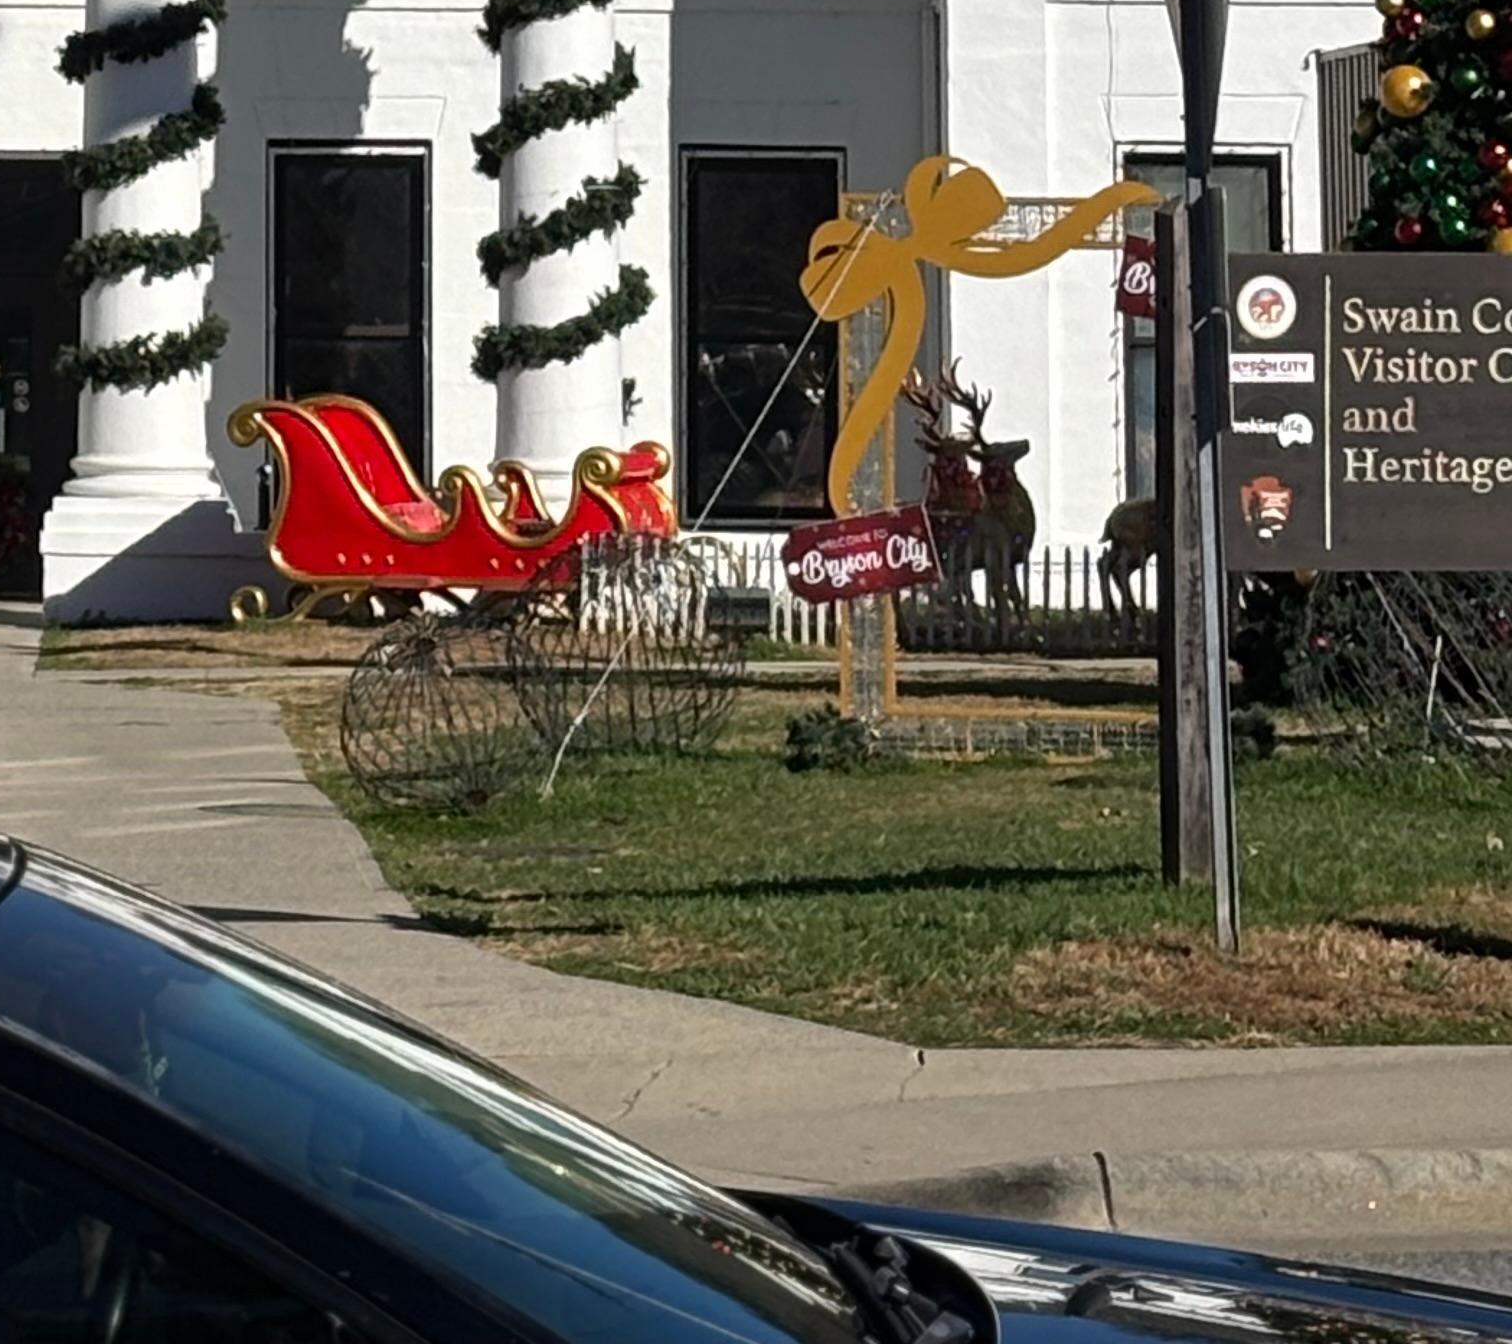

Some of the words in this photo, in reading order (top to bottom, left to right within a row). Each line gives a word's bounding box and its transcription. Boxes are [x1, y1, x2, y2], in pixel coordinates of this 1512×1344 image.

[1343, 297, 1462, 334] Swain
[1341, 348, 1479, 383] Visitor
[1343, 396, 1417, 433] and
[1343, 448, 1512, 494] Heritage
[802, 549, 883, 588] Bryson
[886, 534, 933, 572] City
